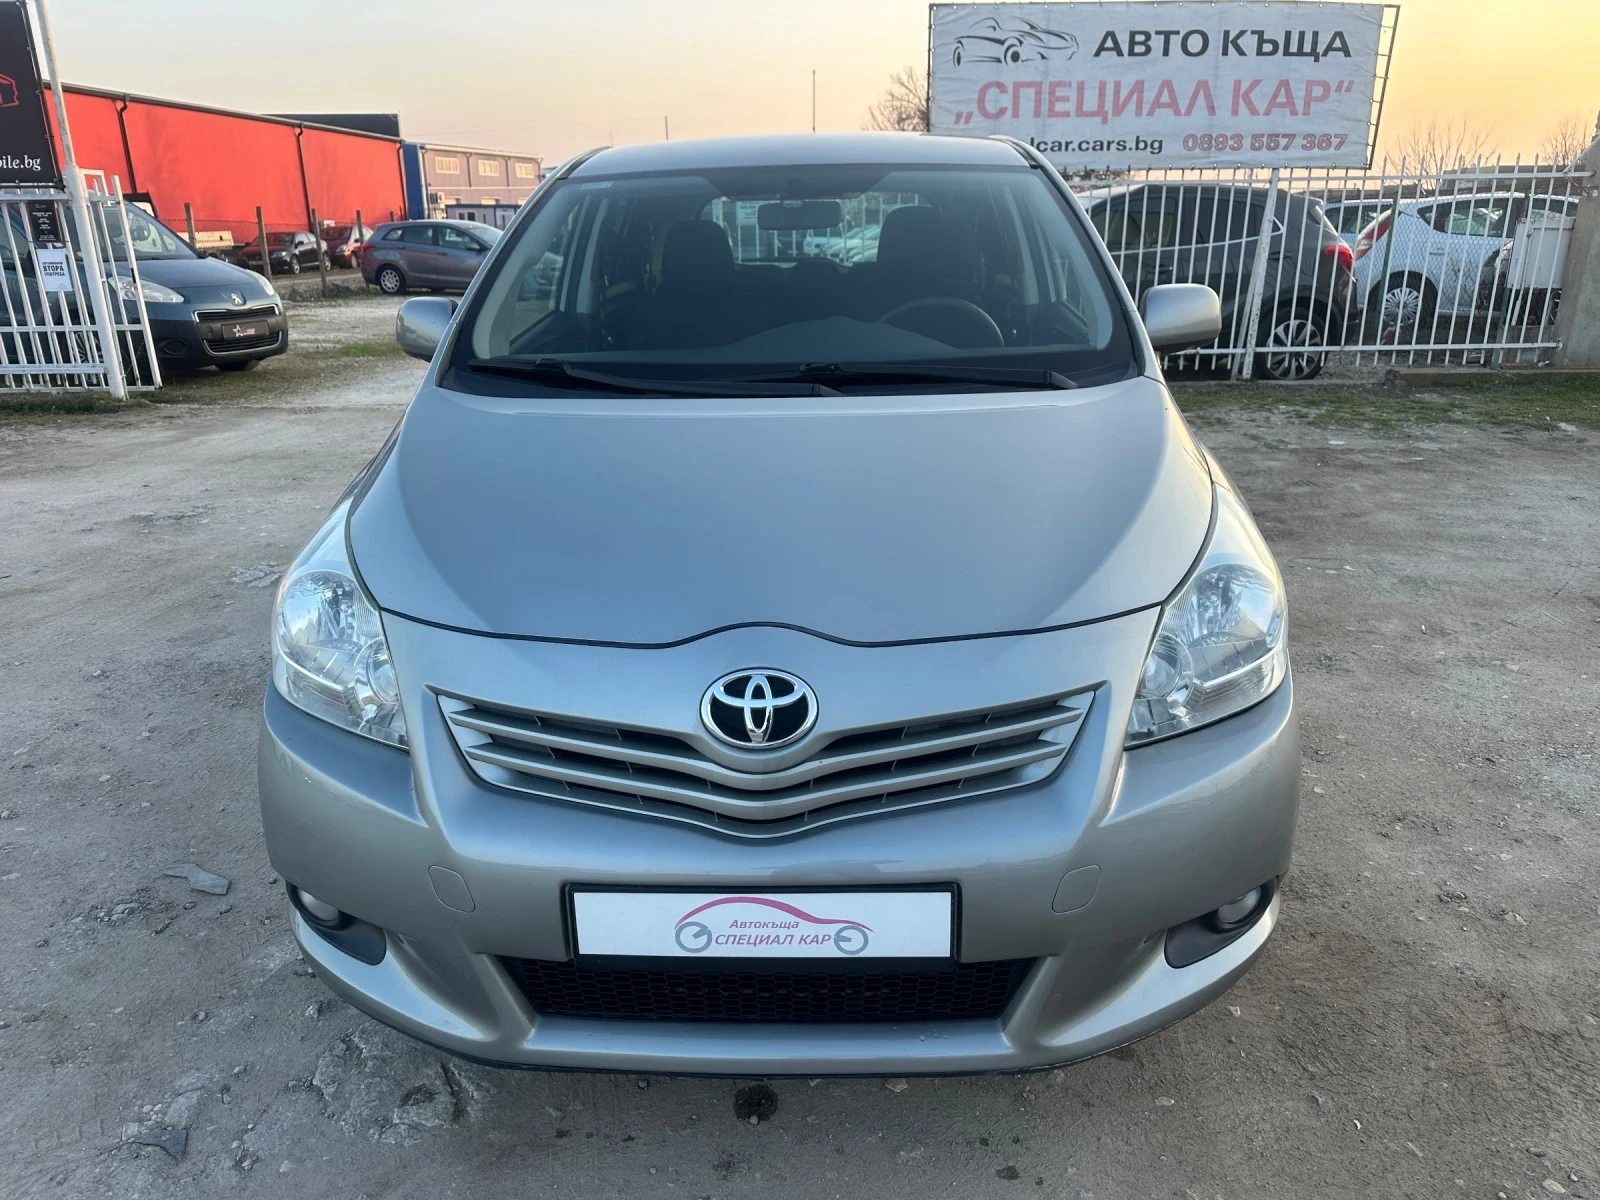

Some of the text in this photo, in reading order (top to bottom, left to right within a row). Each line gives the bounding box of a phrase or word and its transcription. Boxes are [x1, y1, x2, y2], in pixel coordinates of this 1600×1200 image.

[1093, 29, 1352, 63] АВТО КЪЩА
[954, 80, 1215, 125] „СПЕЦИАЛ
[1182, 133, 1348, 152] 0893 557 367
[729, 919, 799, 930] Автокъща
[715, 934, 832, 947] СПЕЦИАЛ КАР
